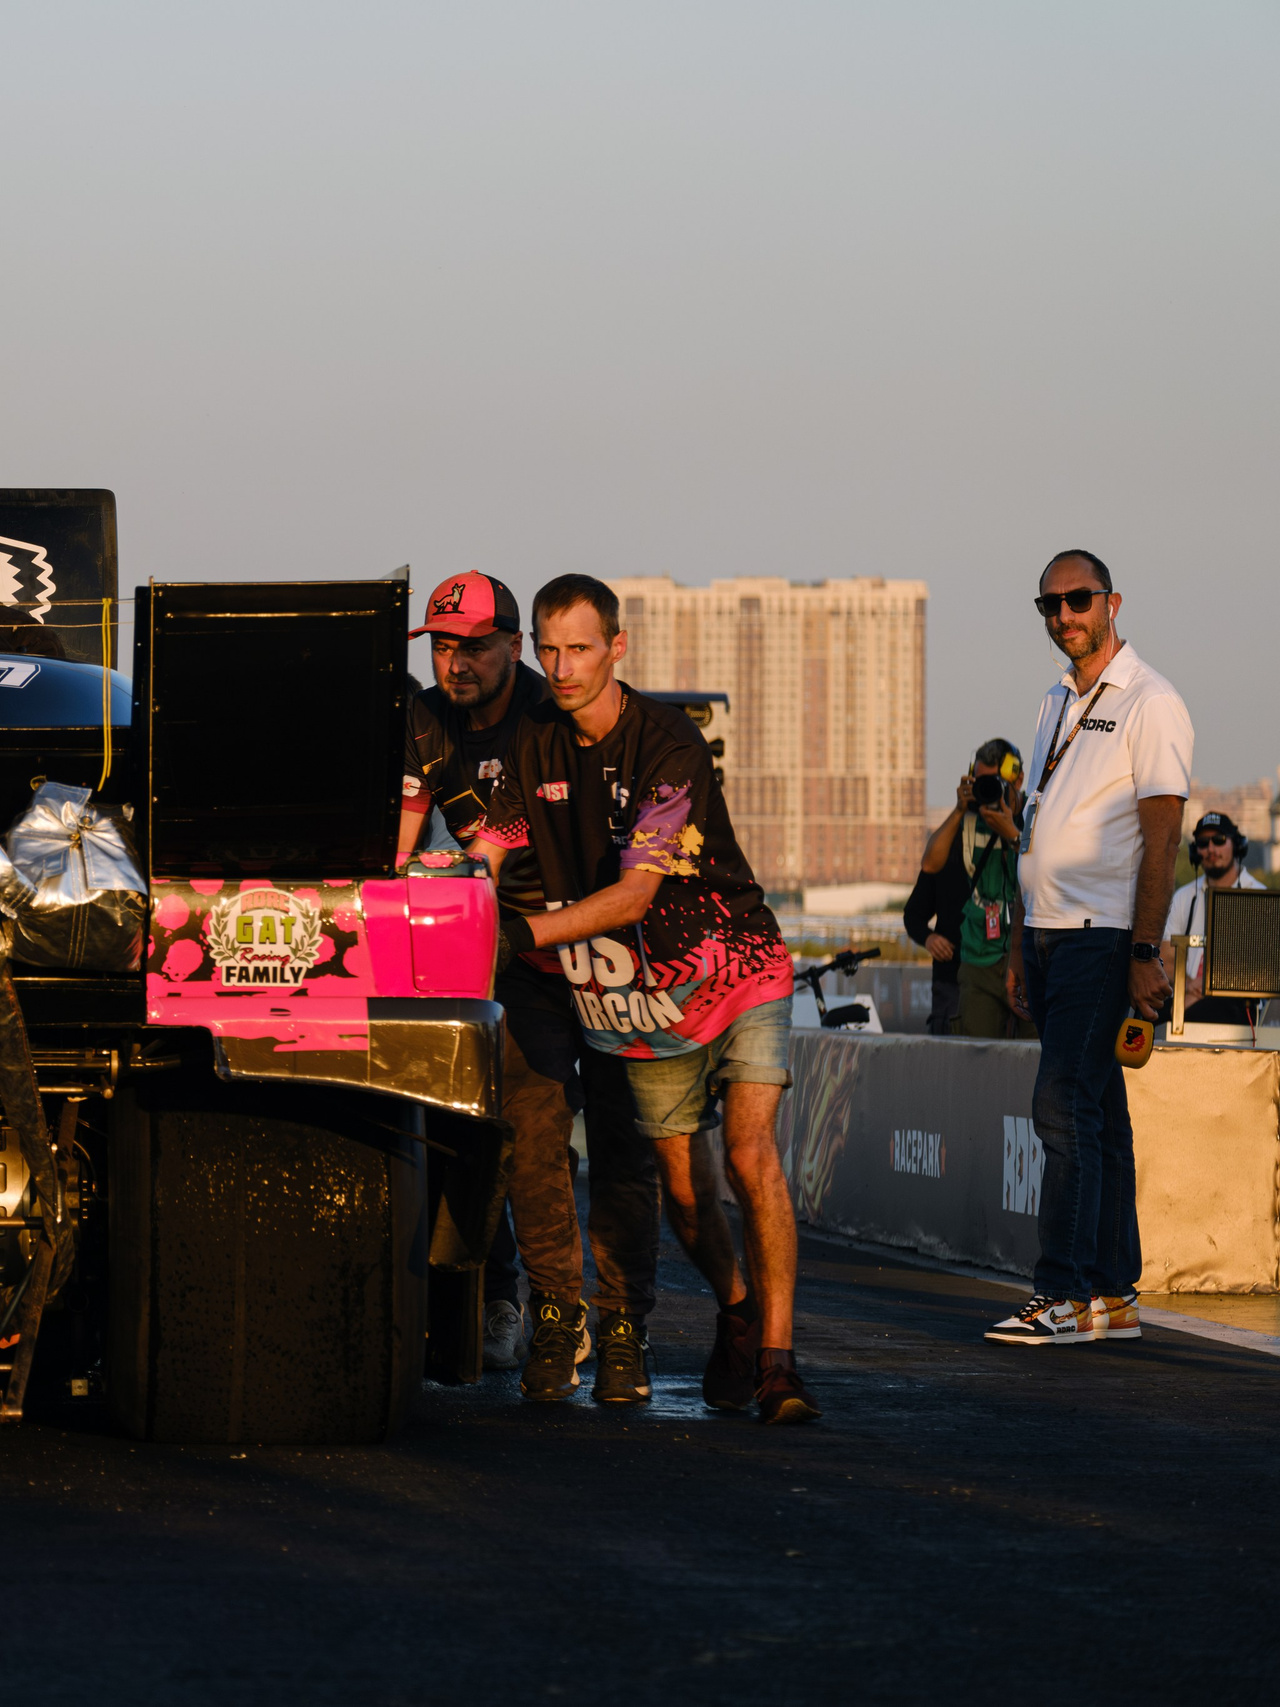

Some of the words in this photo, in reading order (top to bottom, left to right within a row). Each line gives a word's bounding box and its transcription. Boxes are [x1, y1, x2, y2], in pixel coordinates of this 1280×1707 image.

[236, 915, 297, 945] GAT
[225, 965, 304, 984] FAMILY
[239, 947, 292, 969] Racing
[571, 989, 686, 1034] IRCON
[894, 1129, 941, 1179] RACEPARK
[1002, 1115, 1047, 1217] RDR
